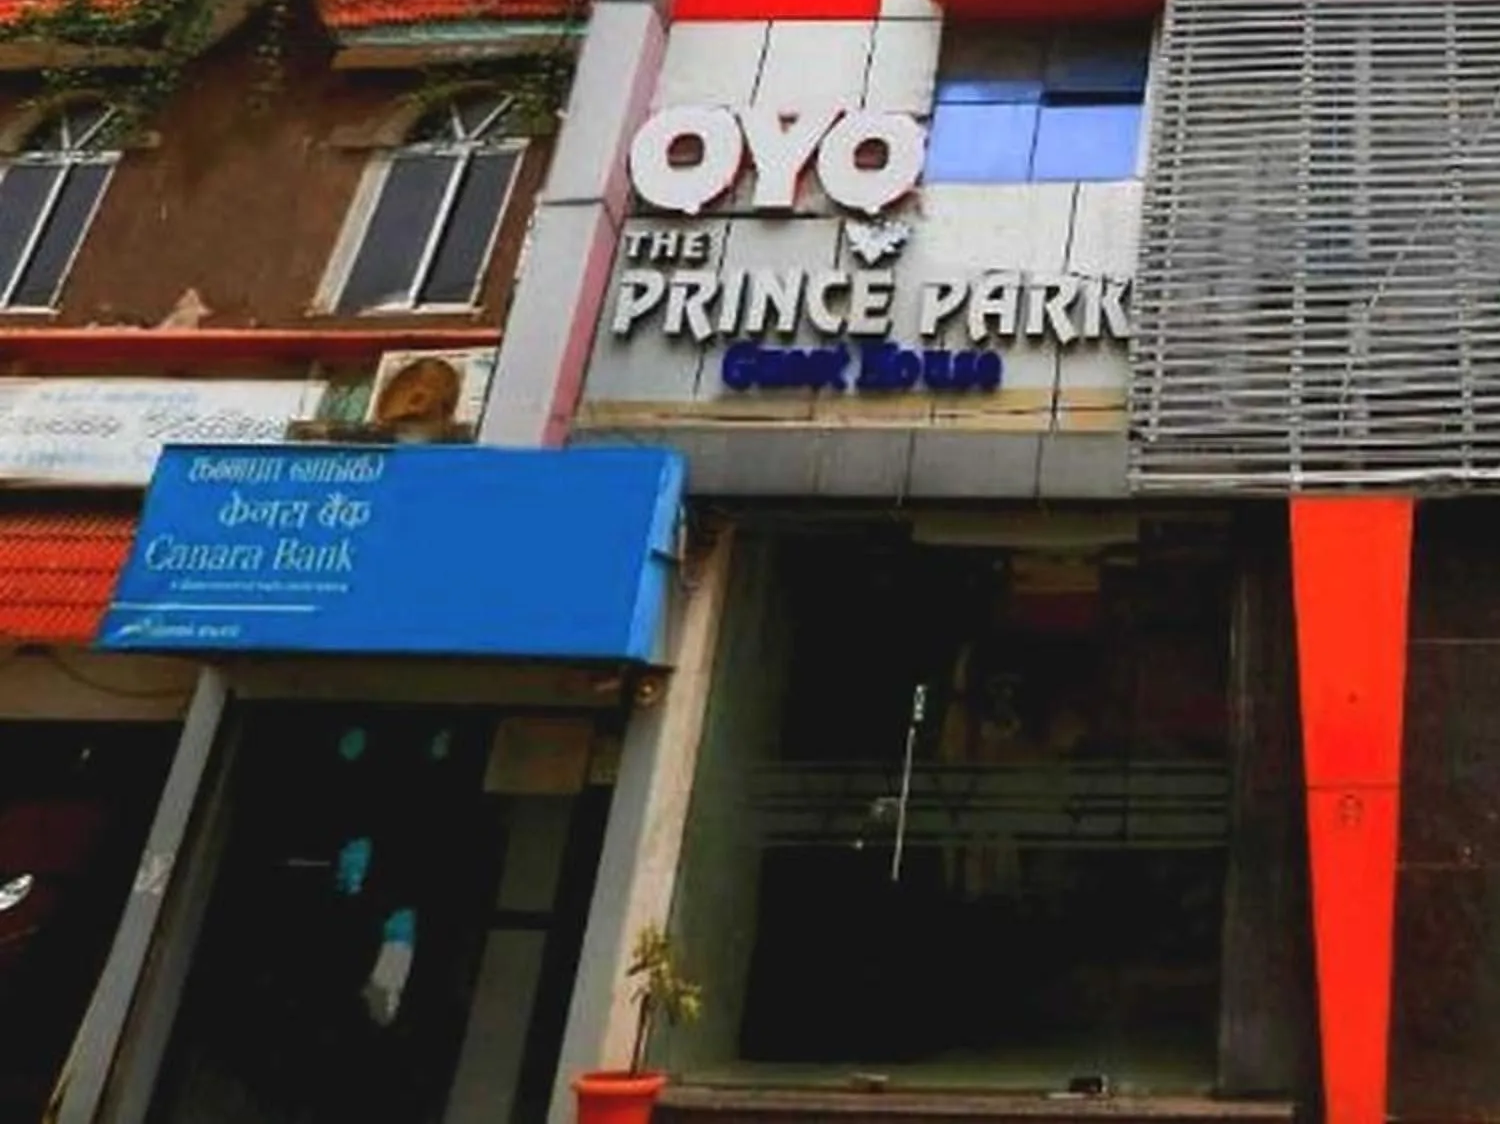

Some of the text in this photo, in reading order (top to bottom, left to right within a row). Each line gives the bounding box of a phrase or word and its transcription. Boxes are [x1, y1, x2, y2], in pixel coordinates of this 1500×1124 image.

[630, 106, 928, 217] OYO
[625, 230, 709, 259] THE
[612, 270, 1133, 344] PRINCE PARK
[145, 532, 353, 572] Canara Bank
